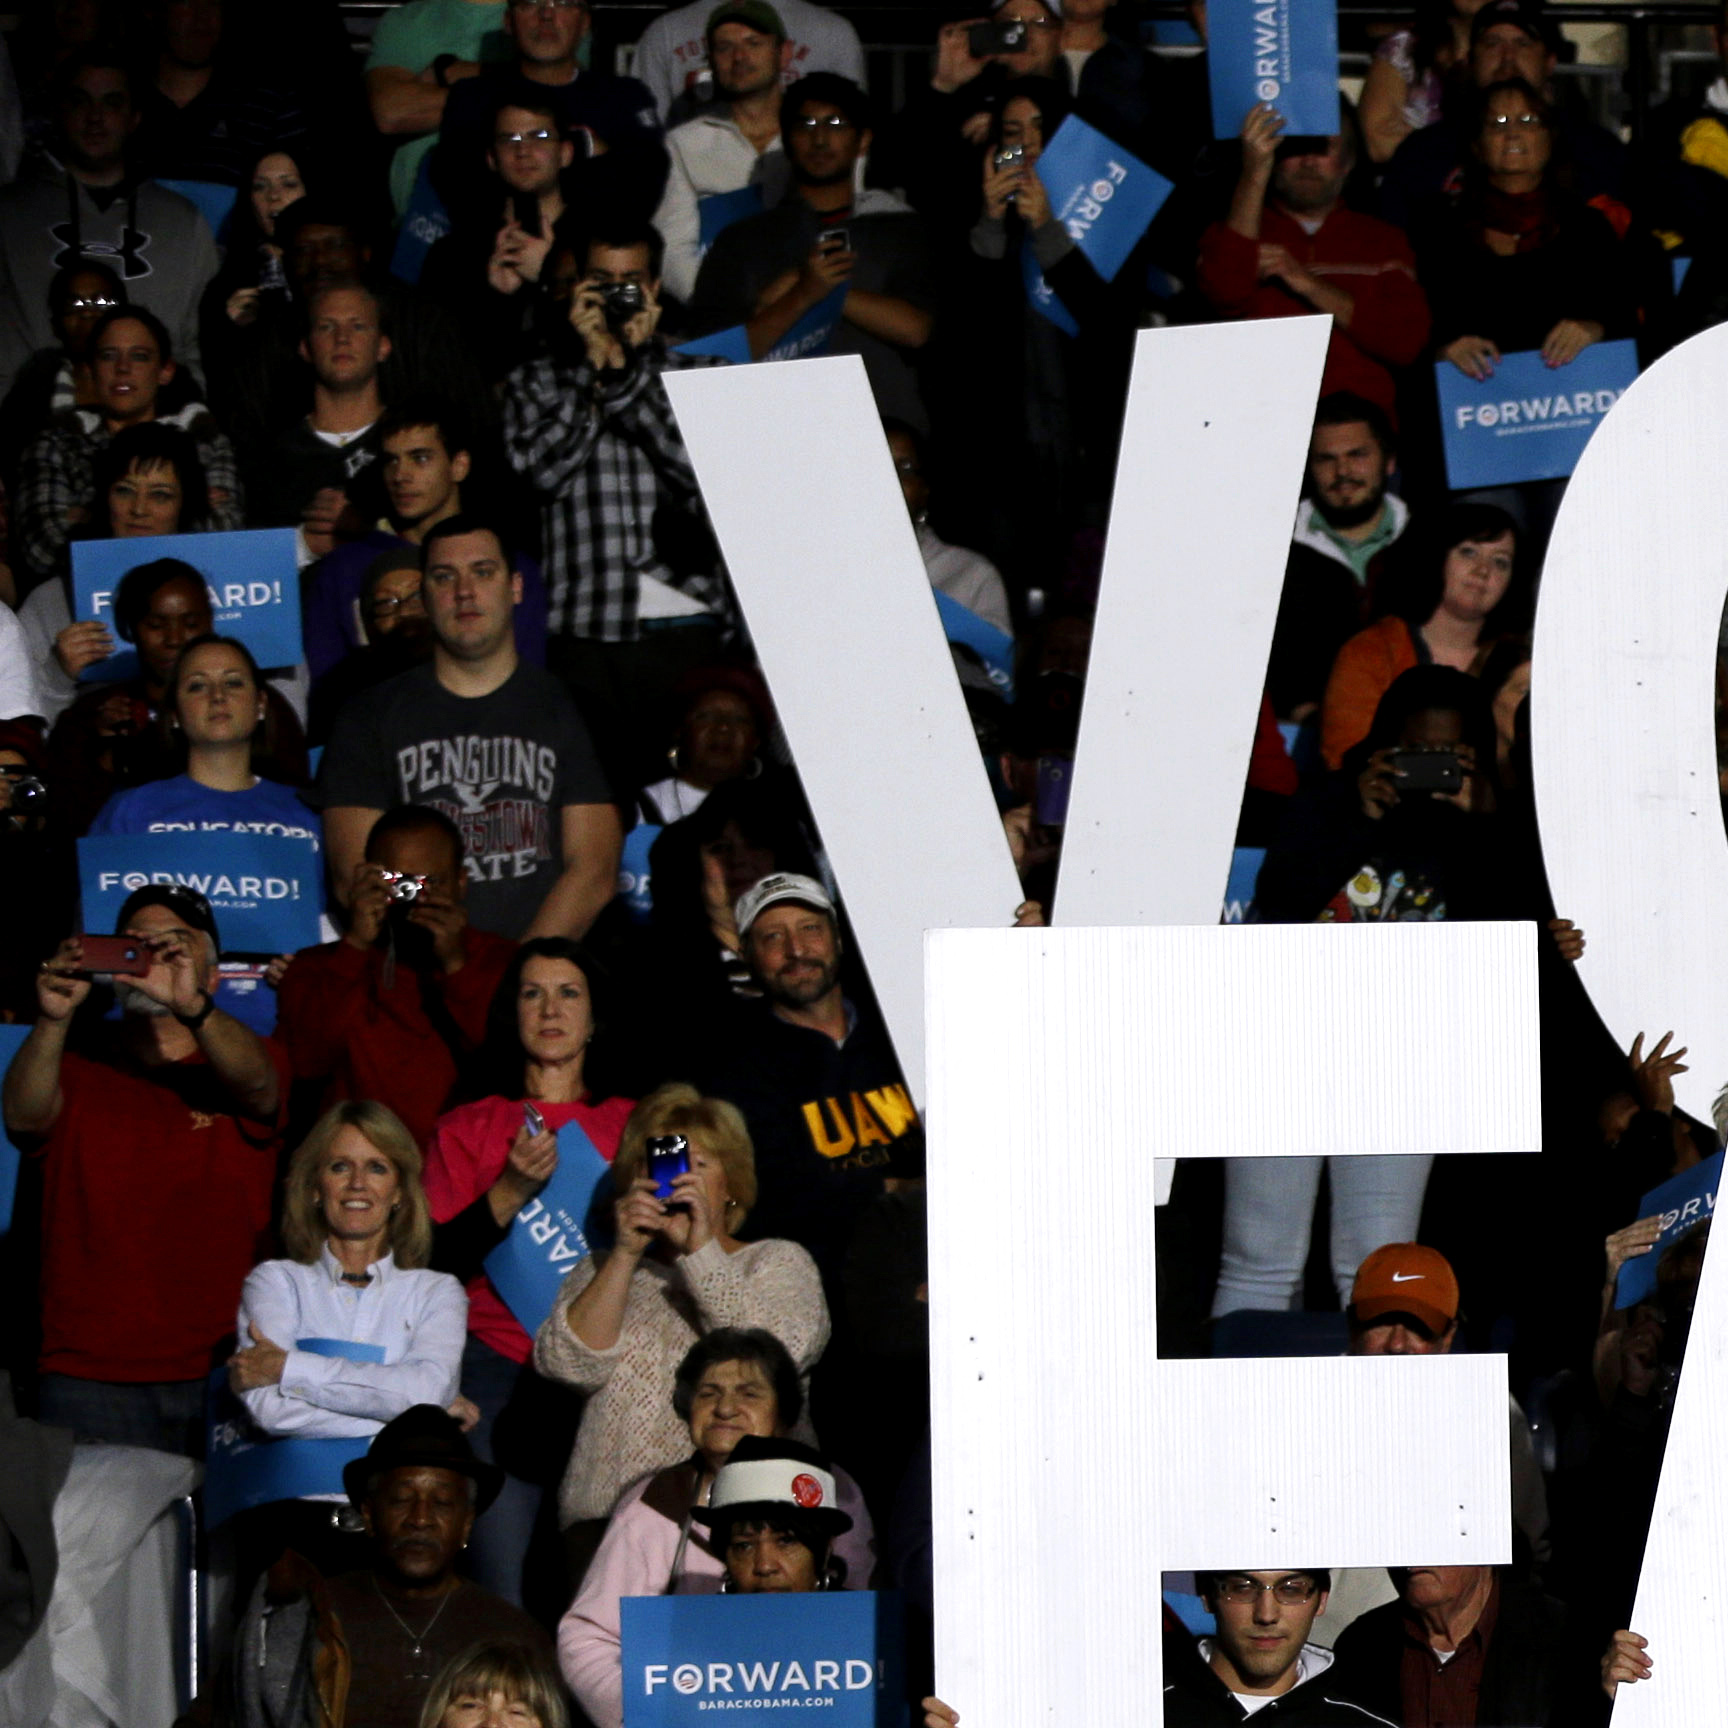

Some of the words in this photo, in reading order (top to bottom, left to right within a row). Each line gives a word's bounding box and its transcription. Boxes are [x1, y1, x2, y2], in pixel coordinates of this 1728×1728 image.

[1456, 391, 1615, 428] FORWARD
[93, 581, 282, 615] FARD!
[399, 734, 558, 806] PENGUINS
[646, 1660, 886, 1695] FORWARD!
[699, 1697, 835, 1711] BARACKOBAMA.COM
